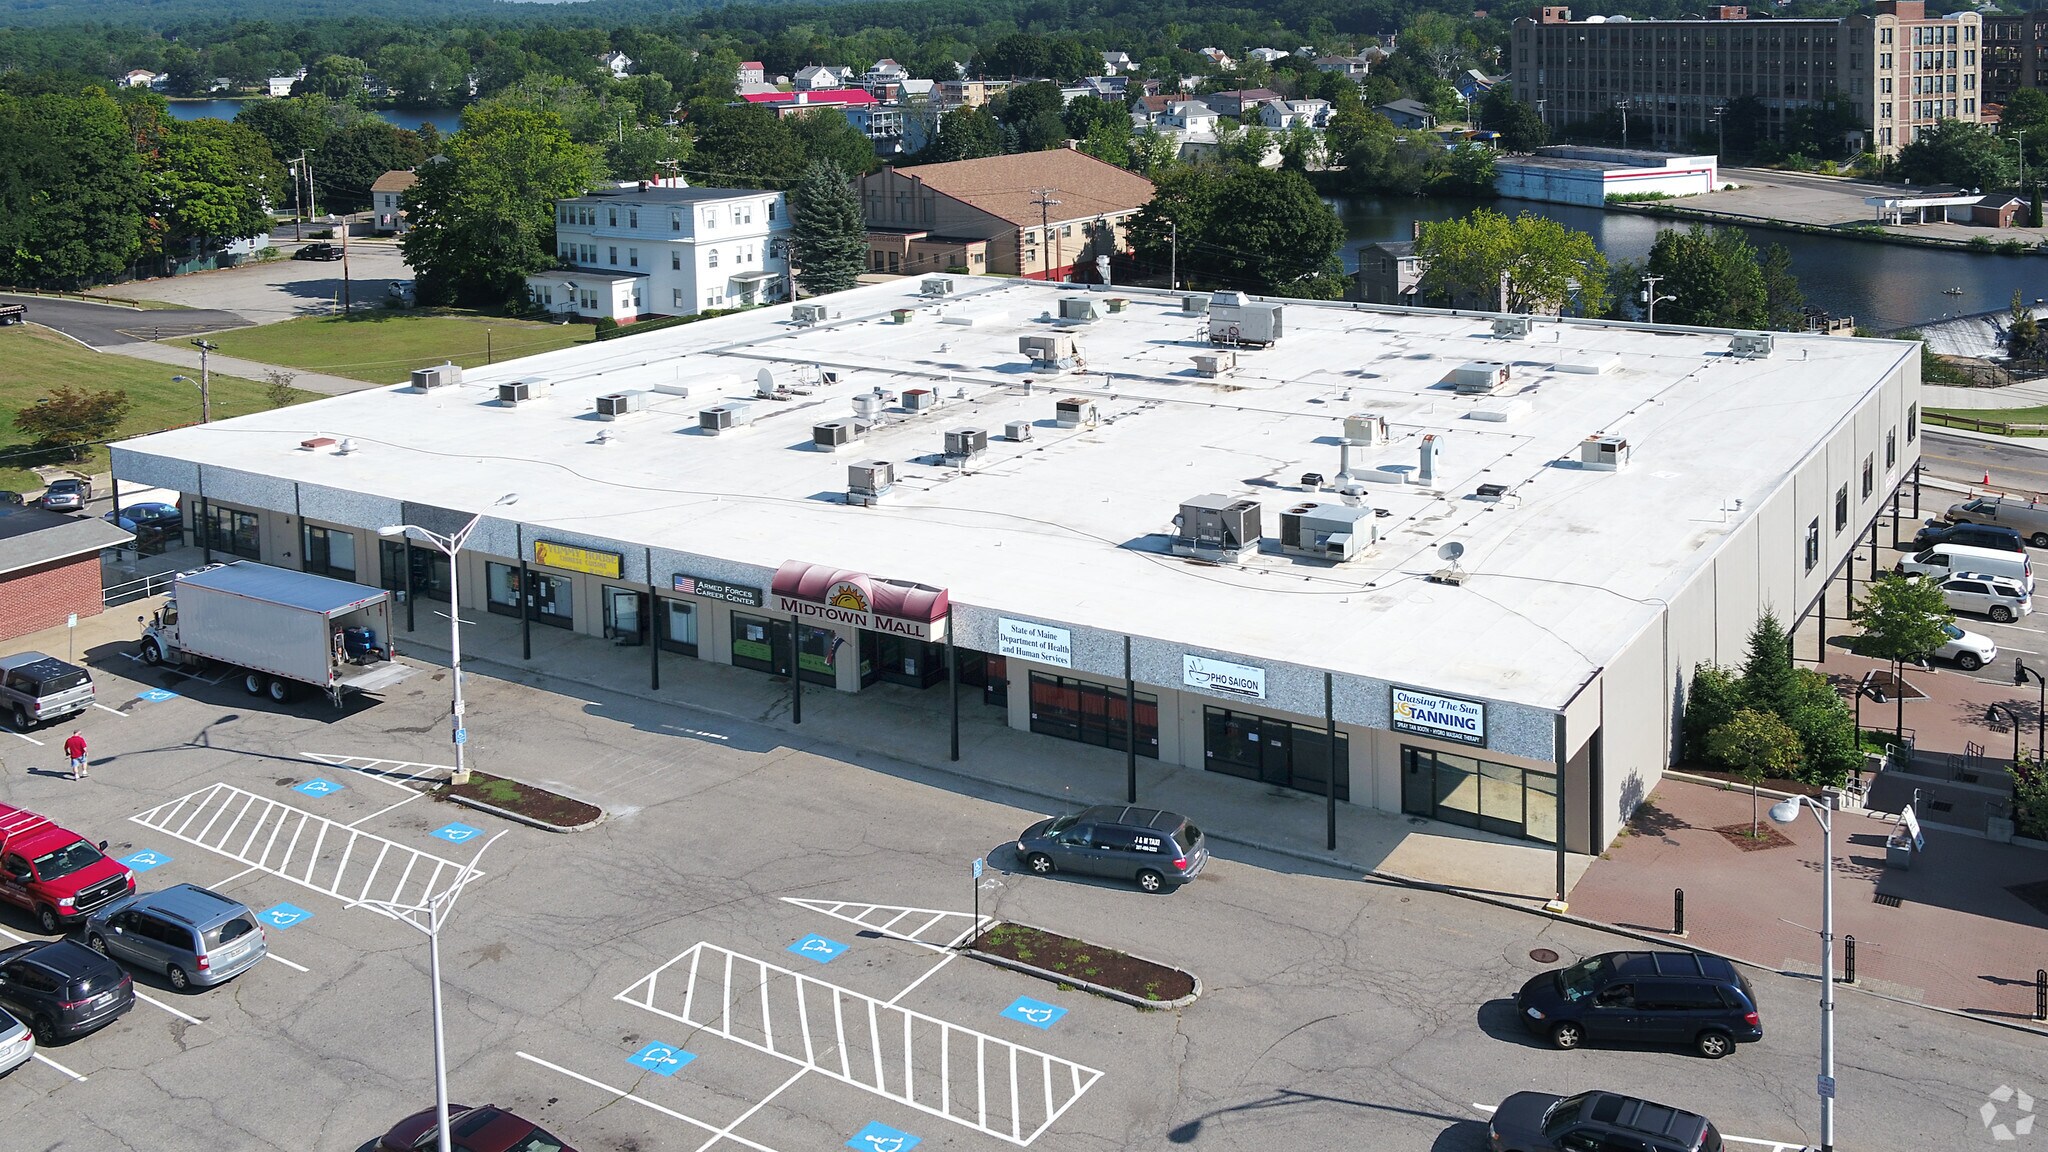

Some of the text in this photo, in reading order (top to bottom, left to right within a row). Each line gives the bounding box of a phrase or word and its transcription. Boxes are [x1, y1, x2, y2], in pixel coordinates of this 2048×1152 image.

[695, 588, 755, 605] CAREER CENTER
[698, 581, 753, 598] ARMED FORCES
[781, 598, 925, 637] MIDTOWN MALL
[1011, 624, 1028, 635] State
[1037, 629, 1058, 640] Maine
[1000, 633, 1070, 654] Department of Health
[1002, 646, 1068, 664] and Human Services
[1211, 673, 1258, 690] PHO SAIGON
[1397, 692, 1478, 715] Chasing The Sun
[1409, 707, 1476, 730] TANNING
[1149, 838, 1160, 846] TAXI
